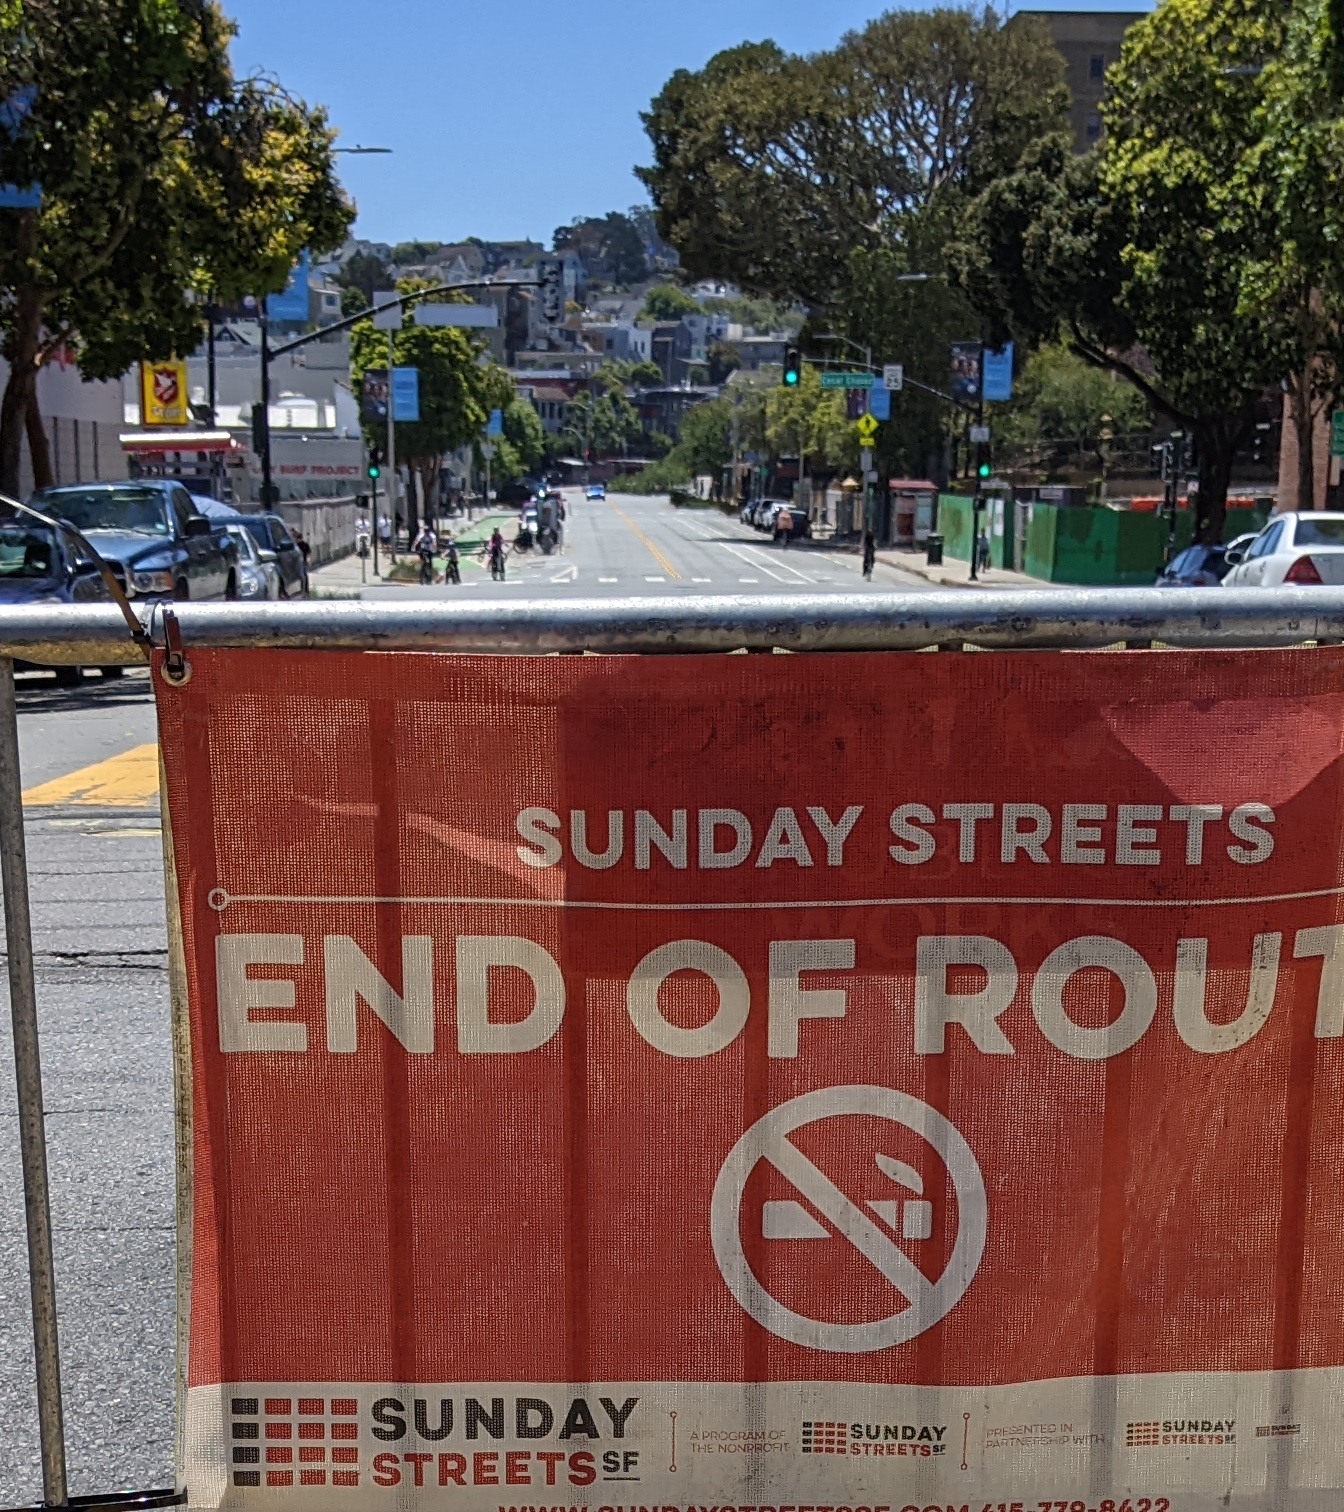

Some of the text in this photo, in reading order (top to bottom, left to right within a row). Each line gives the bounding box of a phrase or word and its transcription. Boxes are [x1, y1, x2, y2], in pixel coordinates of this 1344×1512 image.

[311, 465, 359, 475] PROJECT
[515, 804, 863, 869] SUNDAY
[888, 802, 1276, 866] STREETS
[215, 933, 567, 1054] END
[626, 938, 855, 1059] OF
[371, 1397, 639, 1441] SUNDAY
[1162, 1420, 1236, 1433] SUNDAY
[690, 1430, 787, 1441] A PROGRAM OF
[849, 1423, 947, 1442] SUNDAY
[986, 1423, 1073, 1438] PRESENTED IN
[1072, 1433, 1106, 1445] WITH
[1162, 1434, 1225, 1445] STREETS
[691, 1442, 790, 1453] THE NONPROFIT
[849, 1442, 947, 1457] STREETS SF
[372, 1450, 640, 1487] STREETS SF
